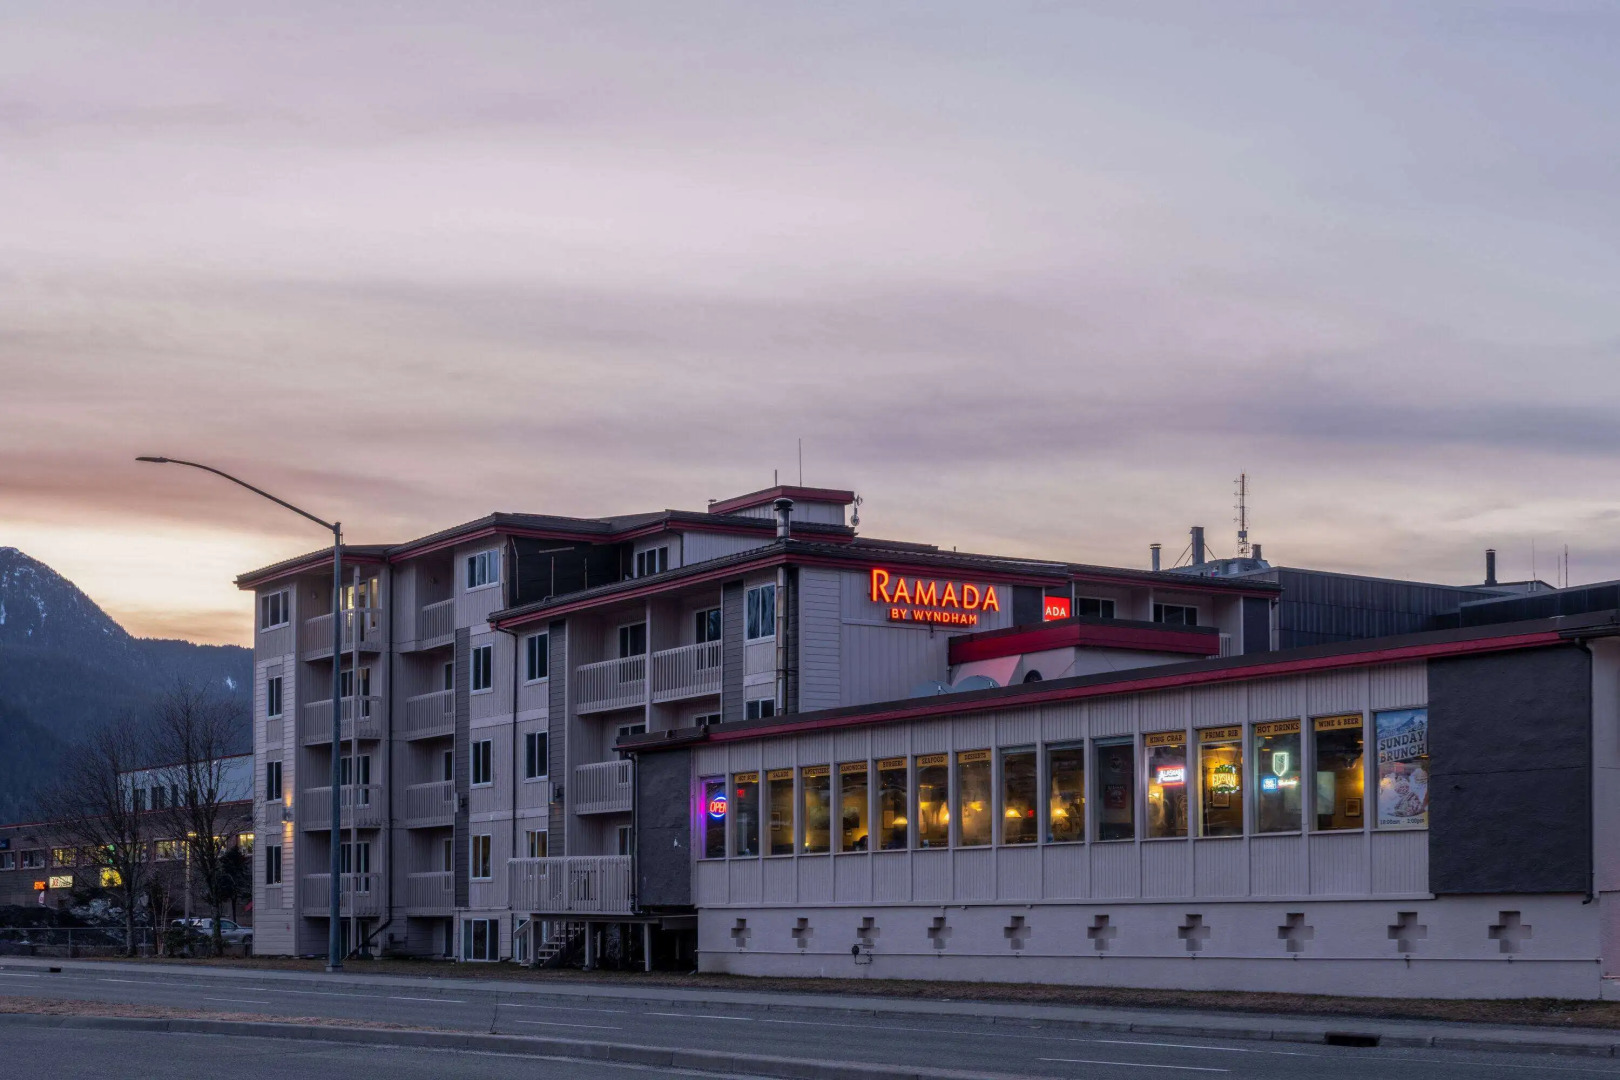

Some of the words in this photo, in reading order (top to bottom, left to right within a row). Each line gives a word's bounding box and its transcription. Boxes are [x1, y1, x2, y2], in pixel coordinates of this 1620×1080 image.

[890, 608, 908, 620] BY
[911, 609, 978, 626] WYNDHAM
[1256, 725, 1272, 734] HOT
[1273, 722, 1299, 732] DRINKS
[1318, 720, 1335, 728] WINE
[1343, 717, 1360, 726] BEER
[1149, 735, 1165, 744] KING
[1166, 734, 1183, 742] CRAB
[1205, 731, 1226, 739] PRIME
[1380, 730, 1425, 751] SUNDAY
[1380, 743, 1425, 763] BRUNCH
[882, 760, 904, 768] BURGERS
[921, 756, 945, 765] SEAFOOD
[709, 801, 728, 813] OPEN
